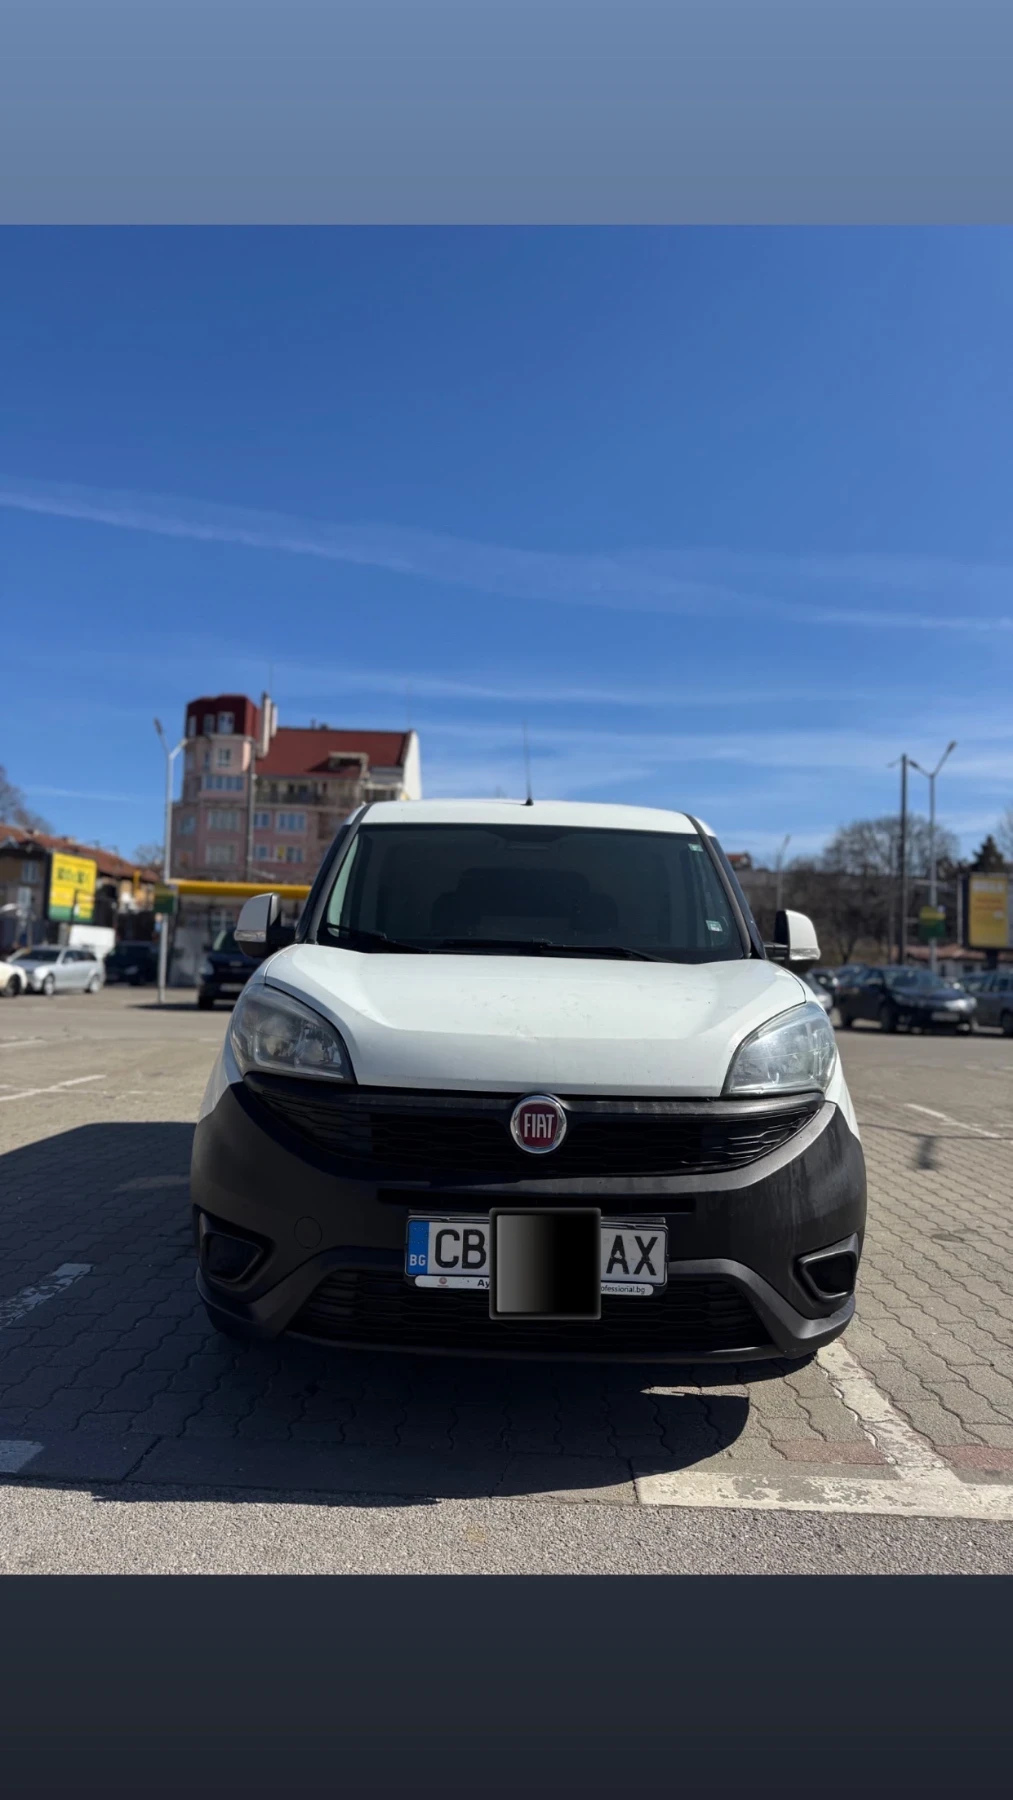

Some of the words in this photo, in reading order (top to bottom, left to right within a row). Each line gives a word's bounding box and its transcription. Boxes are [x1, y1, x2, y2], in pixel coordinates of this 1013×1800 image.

[524, 1113, 555, 1139] FIAT
[409, 1254, 427, 1267] BG
[434, 1228, 487, 1270] CB
[606, 1234, 659, 1276] AX
[601, 1285, 646, 1295] ofessional.bg
